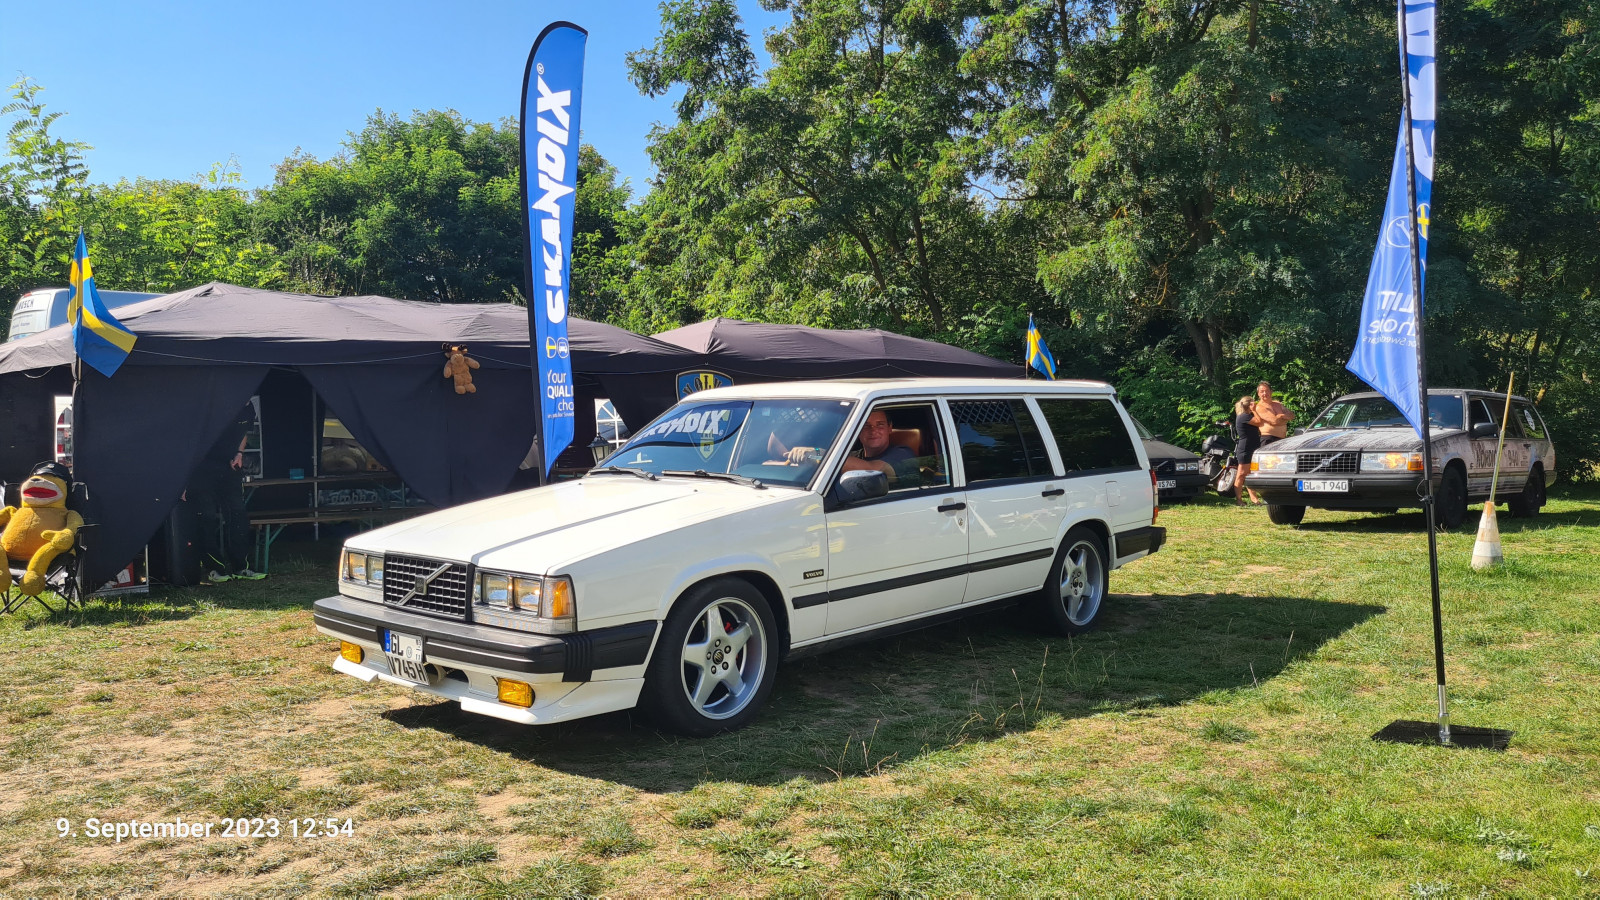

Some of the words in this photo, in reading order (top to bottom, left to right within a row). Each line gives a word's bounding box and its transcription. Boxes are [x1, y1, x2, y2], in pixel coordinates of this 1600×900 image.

[547, 369, 567, 384] Your
[1303, 482, 1315, 491] GL
[1321, 482, 1327, 491] T
[1330, 482, 1347, 491] 940
[805, 570, 823, 578] VOLVO
[390, 633, 404, 657] GL
